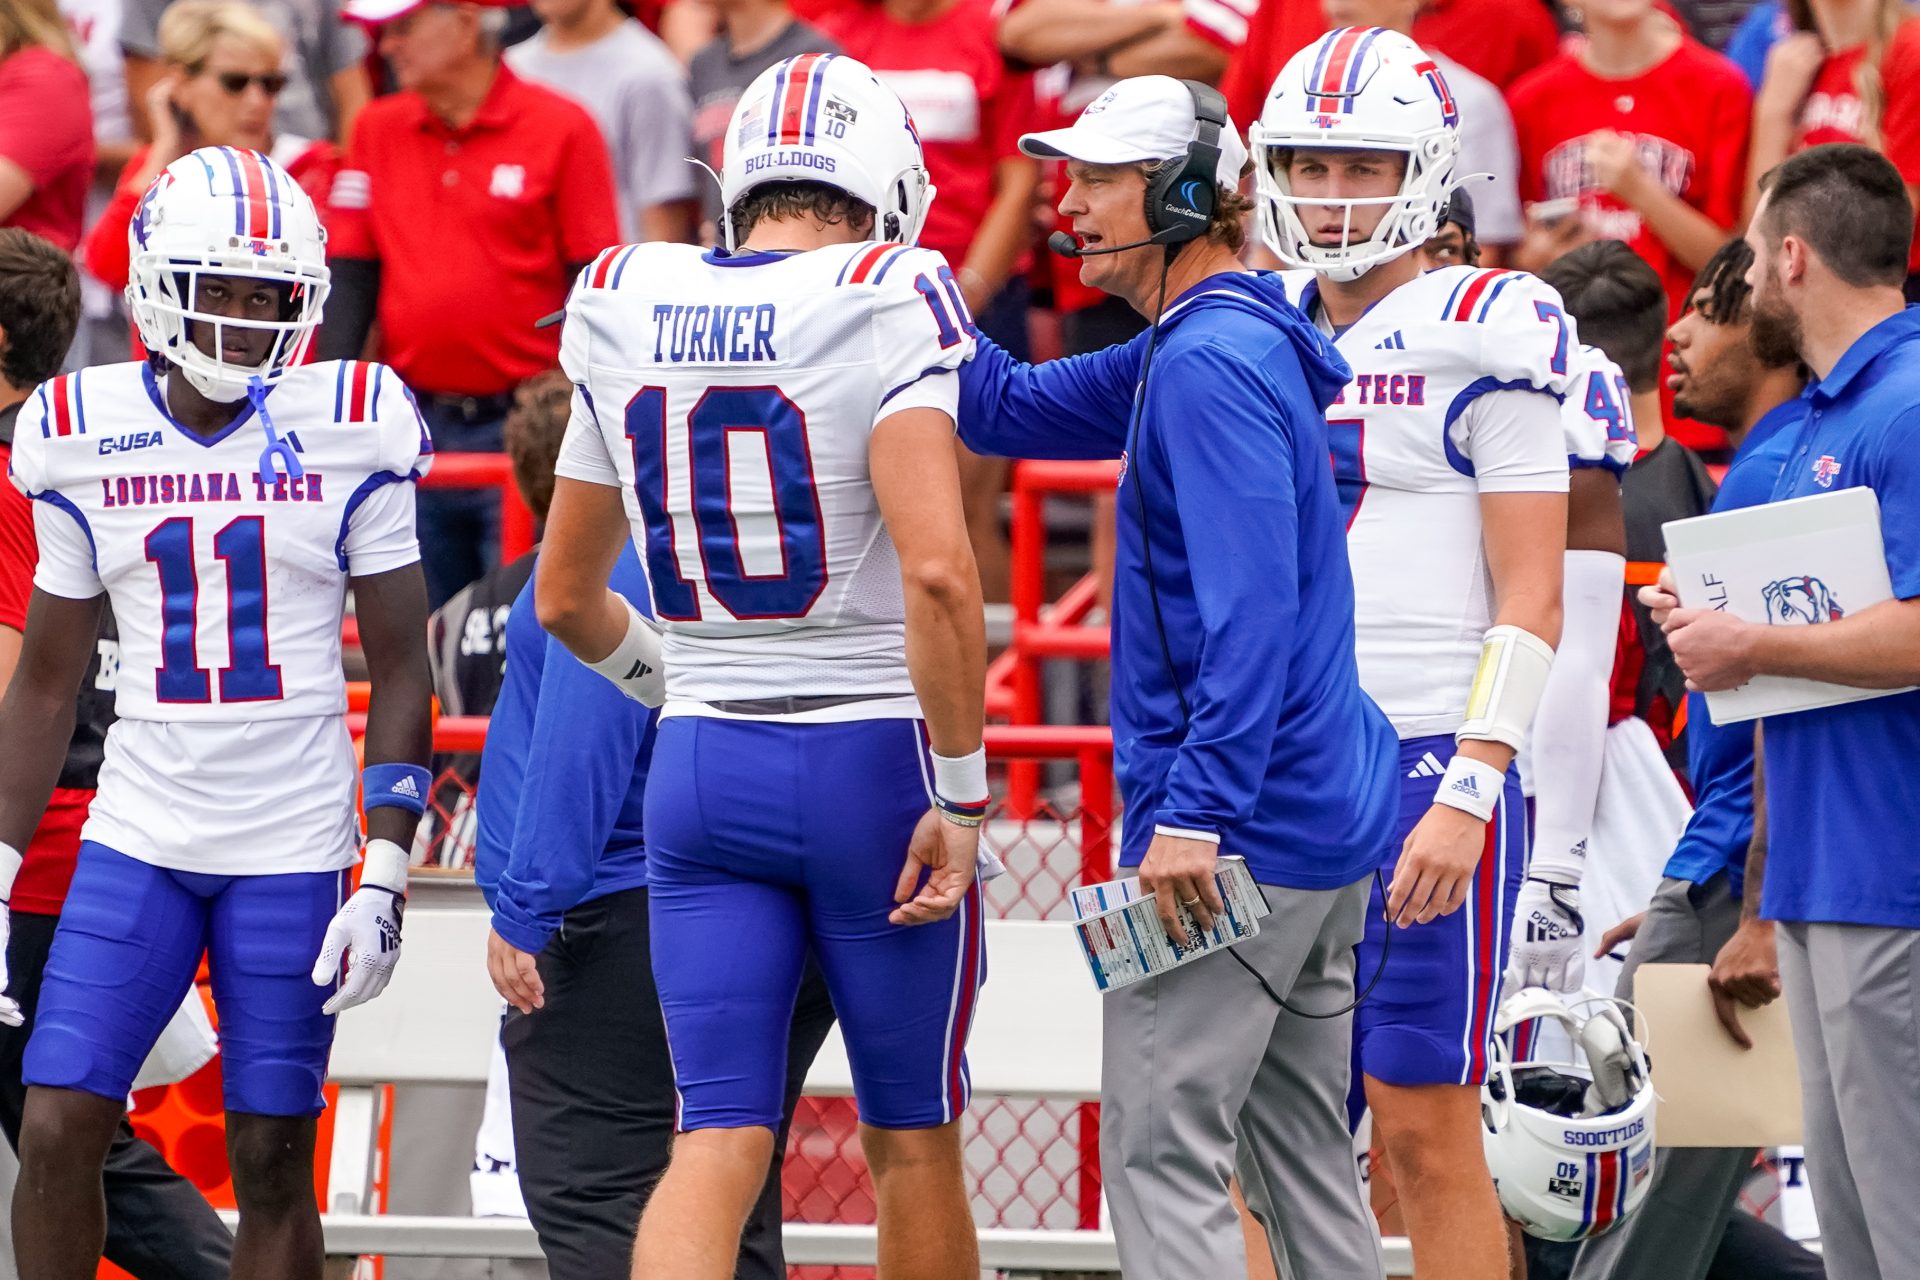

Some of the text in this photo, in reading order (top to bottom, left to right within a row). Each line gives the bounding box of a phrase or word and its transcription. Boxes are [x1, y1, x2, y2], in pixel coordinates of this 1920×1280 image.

[825, 119, 846, 139] 10
[745, 151, 836, 175] BULLDOGS
[913, 265, 977, 350] 10
[653, 303, 776, 363] TURNER
[1533, 299, 1567, 376] 7
[1357, 374, 1426, 406] TECH
[101, 472, 323, 507] LOUISIANA TECH
[624, 385, 829, 622] 10
[144, 515, 284, 704] 11
[391, 783, 420, 799] adidas
[1451, 782, 1480, 799] adidas
[1563, 1117, 1645, 1146] BULLDOGS
[1556, 1161, 1580, 1180] 40
